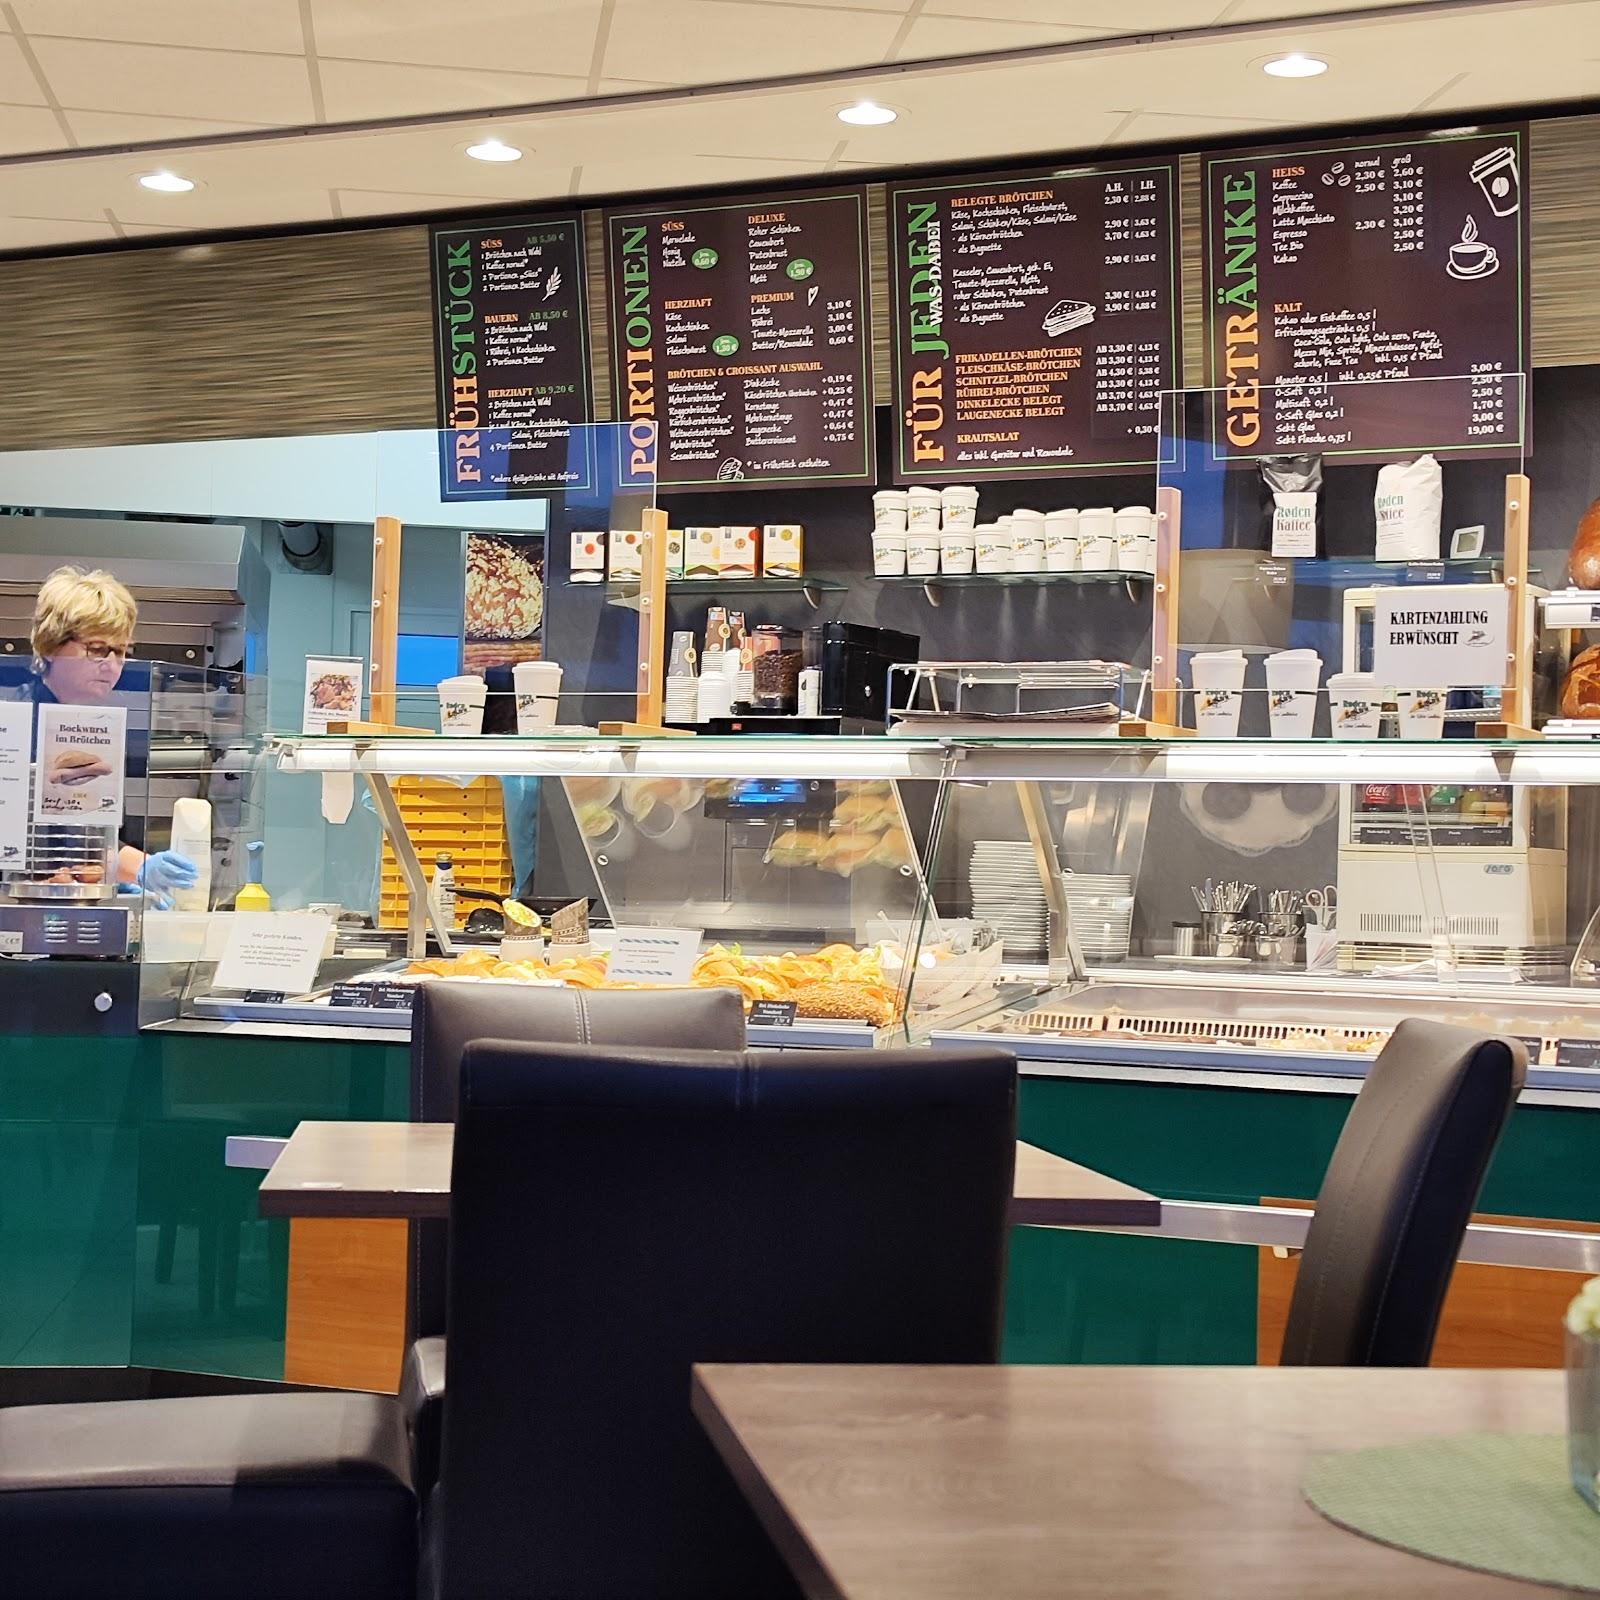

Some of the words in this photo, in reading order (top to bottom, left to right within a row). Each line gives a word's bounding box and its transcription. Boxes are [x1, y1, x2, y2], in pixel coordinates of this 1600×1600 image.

[1354, 157, 1380, 168] normal
[1391, 154, 1412, 168] groß
[1272, 167, 1305, 178] HEISS
[1355, 172, 1375, 181] 2,30
[1393, 169, 1414, 177] 2,60
[1272, 179, 1298, 190] Kaffee
[1355, 185, 1376, 193] 2,50
[1393, 181, 1413, 190] 3,10
[951, 195, 997, 207] BELEGTE
[999, 191, 1053, 203] BRÖTCHEN
[1273, 192, 1313, 207] Cappuccino
[748, 213, 786, 224] DELUXE
[1273, 219, 1295, 227] Latte
[1297, 214, 1335, 226] Macchiato
[662, 222, 684, 231] SÜSS
[748, 227, 768, 236] Roher
[770, 225, 801, 235] Schinken
[1355, 221, 1376, 230] 2,30
[1273, 230, 1307, 241] Espresso
[481, 240, 502, 249] SÜSS
[749, 238, 784, 248] Camembert
[1272, 243, 1288, 252] Tee
[1289, 241, 1303, 250] Bio
[1394, 243, 1414, 252] 2,50
[749, 249, 788, 259] Putenbrust
[927, 220, 942, 281] DABEI
[969, 243, 1002, 256] Baguette
[1273, 254, 1297, 264] Kakao
[486, 261, 505, 270] Kaffee
[750, 275, 767, 284] Mett
[907, 201, 950, 361] JEDEN
[489, 283, 519, 291] Portionen
[520, 281, 540, 290] Butter
[751, 292, 794, 303] PREMIUM
[665, 299, 712, 309] HERZHAFT
[751, 306, 770, 315] Lachs
[827, 301, 844, 310] 3,10
[929, 285, 943, 327] WAS
[1217, 171, 1261, 447] GETRÄNKE
[1274, 303, 1303, 313] KALT
[484, 314, 518, 324] BAUERN
[665, 313, 682, 321] Käse
[828, 313, 845, 322] 3,10
[1274, 316, 1298, 325] Kakao
[1301, 312, 1317, 324] oder
[1320, 310, 1355, 321] Eiskaffee
[666, 323, 710, 333] Kochschinken
[1275, 324, 1355, 338] Erfrischungsgetränke
[666, 335, 687, 345] Salami
[1334, 335, 1350, 344] Cola
[622, 226, 656, 476] PORTIONEN
[667, 345, 707, 355] Fleischwurst
[955, 348, 1082, 363] FRIKADELLEN-BRÖTCHEN
[445, 240, 481, 483] FRÜHSTÜCK
[668, 368, 716, 379] BRÖTCHEN
[726, 365, 777, 376] CROISSANT
[779, 362, 823, 373] AUSWAHL
[955, 360, 1081, 375] FLEISCHKÄSE-BRÖTCHEN
[1471, 364, 1492, 372] 3,00
[955, 372, 1068, 386] SCHNITZEL-BRÖTCHEN
[1275, 376, 1306, 384] Monster
[488, 388, 533, 398] HERZHAFT
[956, 384, 1049, 398] RÜHREI-BRÖTCHEN
[1472, 389, 1493, 397] 2,50
[956, 398, 1021, 409] DINKELECKE
[1023, 396, 1063, 405] BELEGT
[1275, 397, 1311, 409] Multisaft
[906, 368, 944, 462] FÜR
[956, 409, 1024, 421] LAUGENECKE
[1025, 407, 1065, 417] BELEGT
[1468, 426, 1494, 435] 19,00
[957, 432, 1019, 443] KRAUTSALAT
[1275, 434, 1296, 445] Sekt
[1298, 433, 1327, 443] Flasche
[1022, 447, 1035, 458] und
[1391, 611, 1488, 624] KARTENZAHLUNG
[1390, 629, 1459, 645] ERWÜNSCHT
[59, 725, 108, 733] Bockwurst
[70, 736, 111, 744] Brötchen
